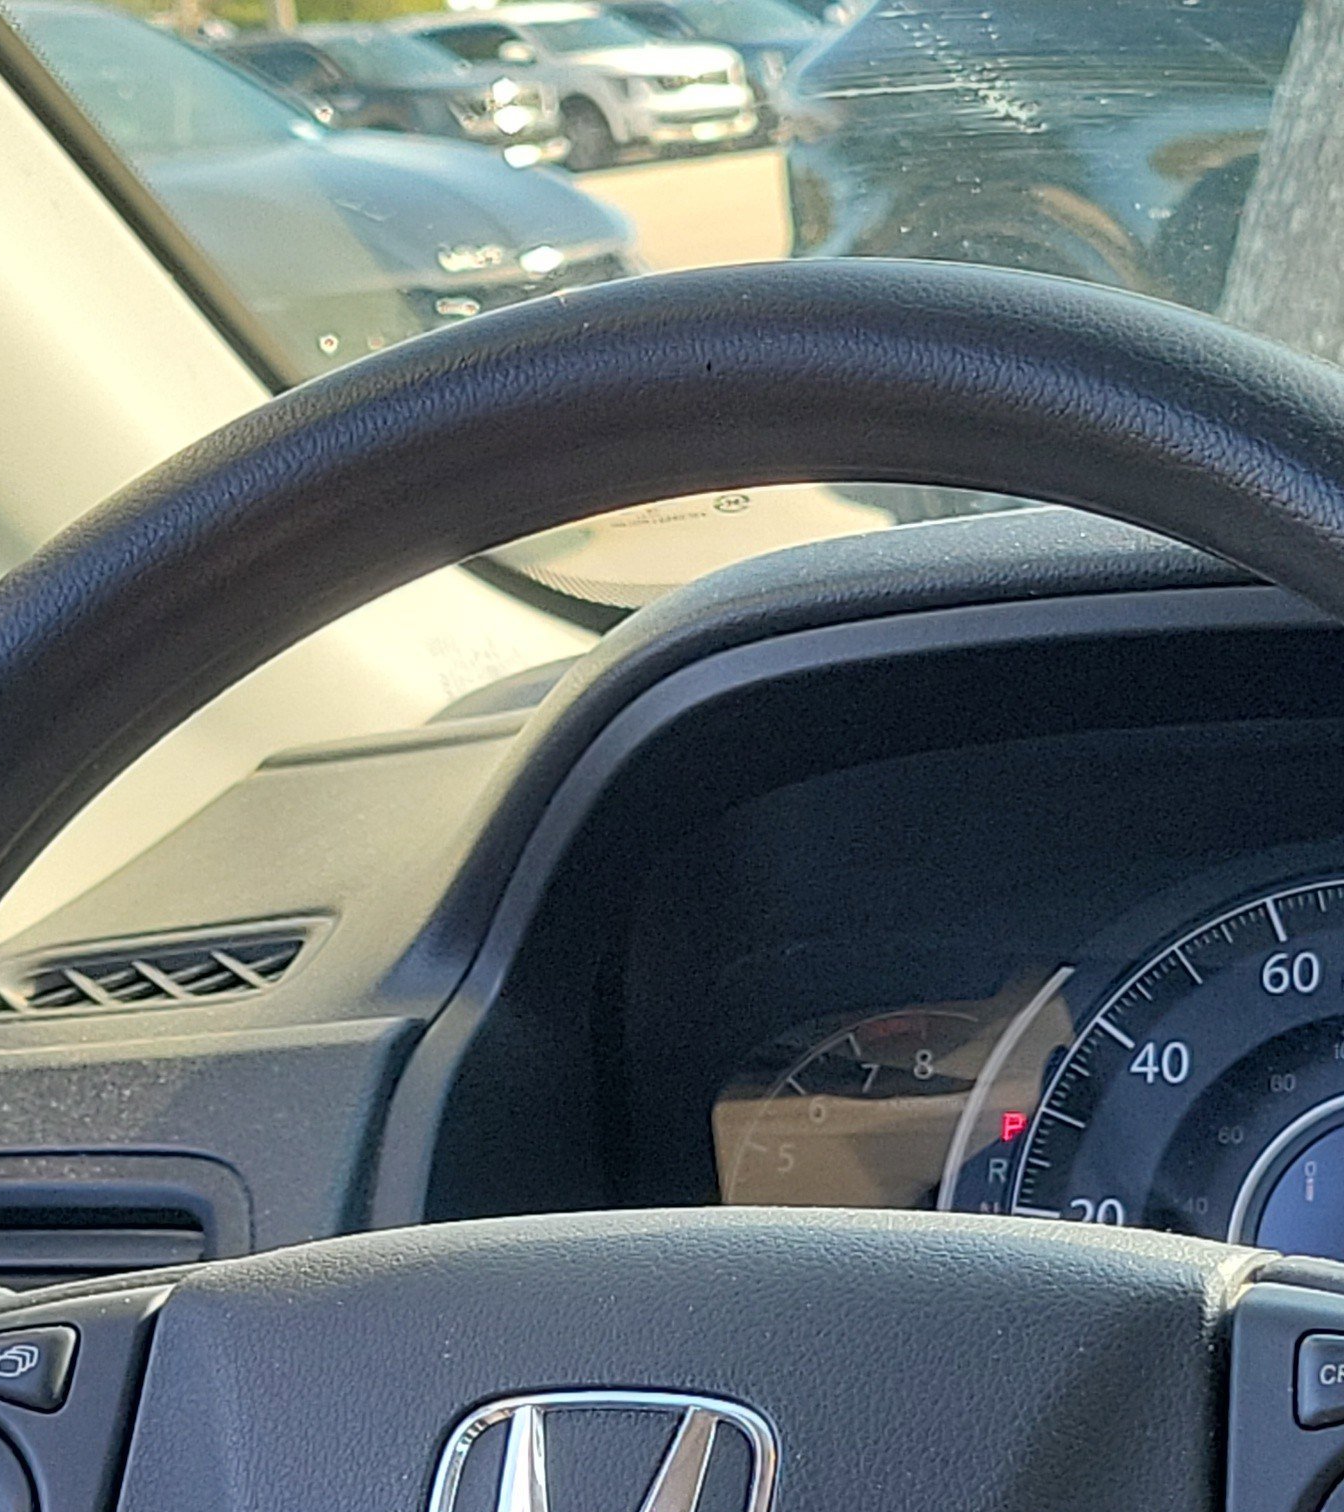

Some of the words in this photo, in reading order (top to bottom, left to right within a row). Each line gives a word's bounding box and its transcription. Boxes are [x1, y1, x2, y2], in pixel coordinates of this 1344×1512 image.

[1263, 952, 1319, 993] 60
[862, 1064, 879, 1092] 7
[913, 1049, 934, 1080] 8
[1130, 1041, 1188, 1084] 40
[1001, 1111, 1027, 1142] P
[777, 1145, 794, 1172] 5
[988, 1158, 1008, 1184] R
